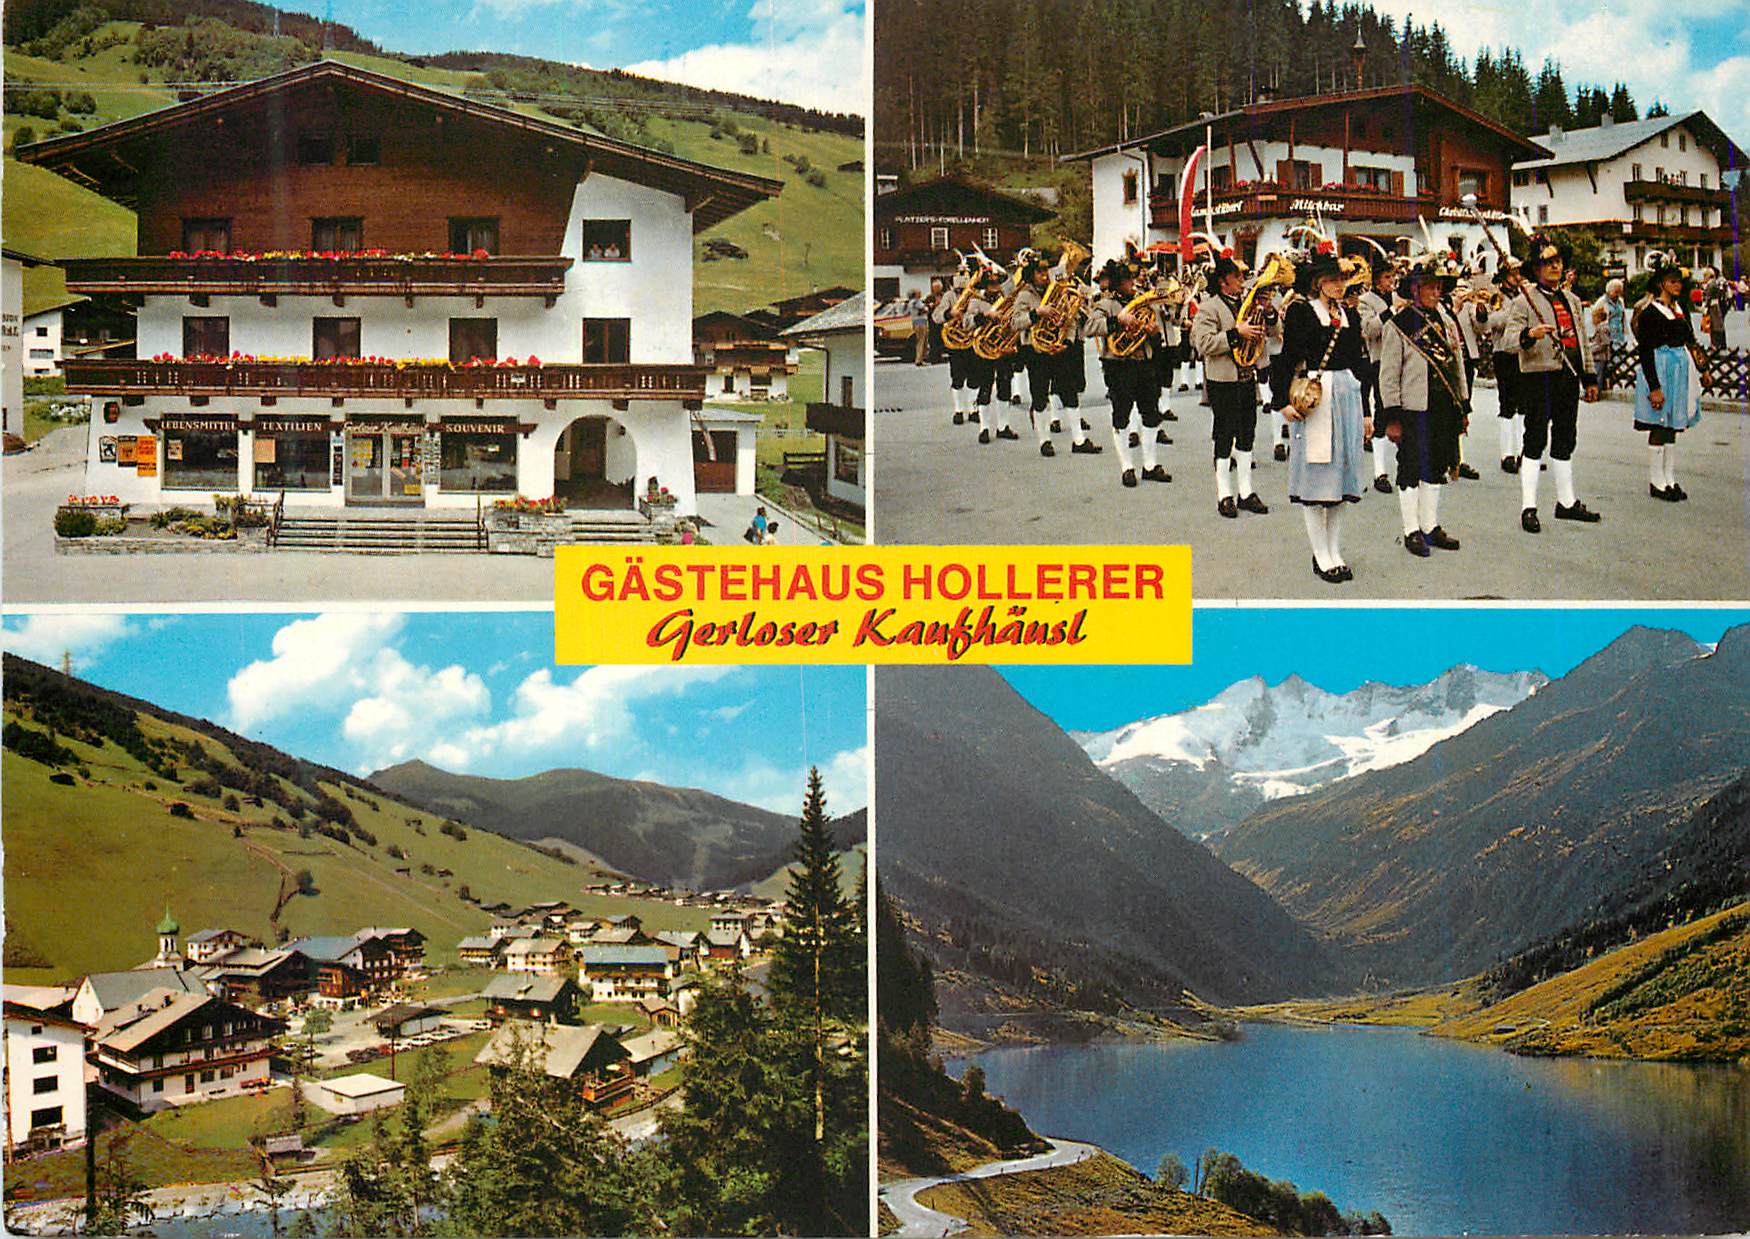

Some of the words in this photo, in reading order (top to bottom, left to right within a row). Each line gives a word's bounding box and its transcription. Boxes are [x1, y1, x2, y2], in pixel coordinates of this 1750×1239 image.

[1290, 199, 1345, 211] Milchbar
[161, 420, 235, 430] LEBENSMITTEL
[262, 422, 322, 431] TEXTILIEN
[446, 423, 505, 433] SOUVENIR
